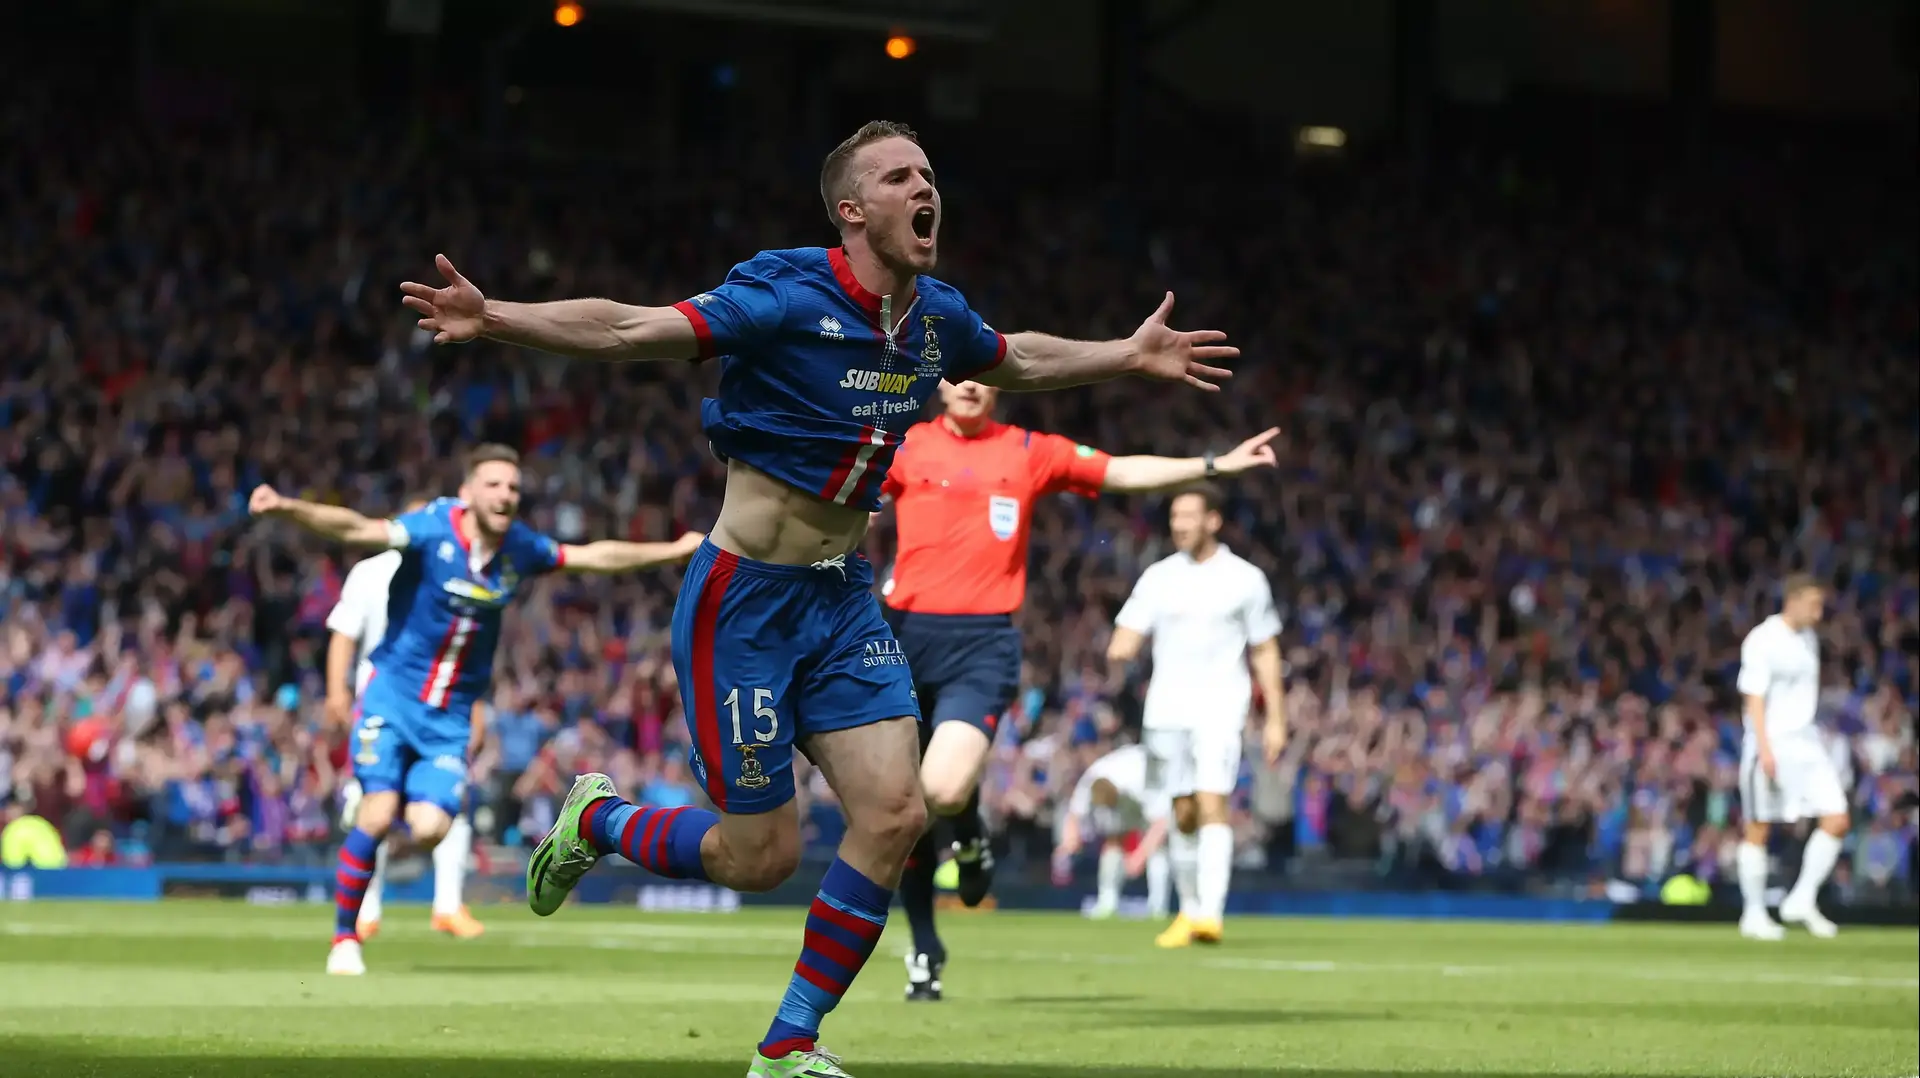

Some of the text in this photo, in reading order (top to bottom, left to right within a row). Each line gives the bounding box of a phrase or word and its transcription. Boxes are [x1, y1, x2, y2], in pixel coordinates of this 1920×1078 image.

[820, 330, 845, 340] errea
[839, 368, 917, 394] SUBWAY
[852, 397, 920, 417] eat fresh.
[863, 639, 904, 657] ALLI
[723, 688, 779, 744] 15
